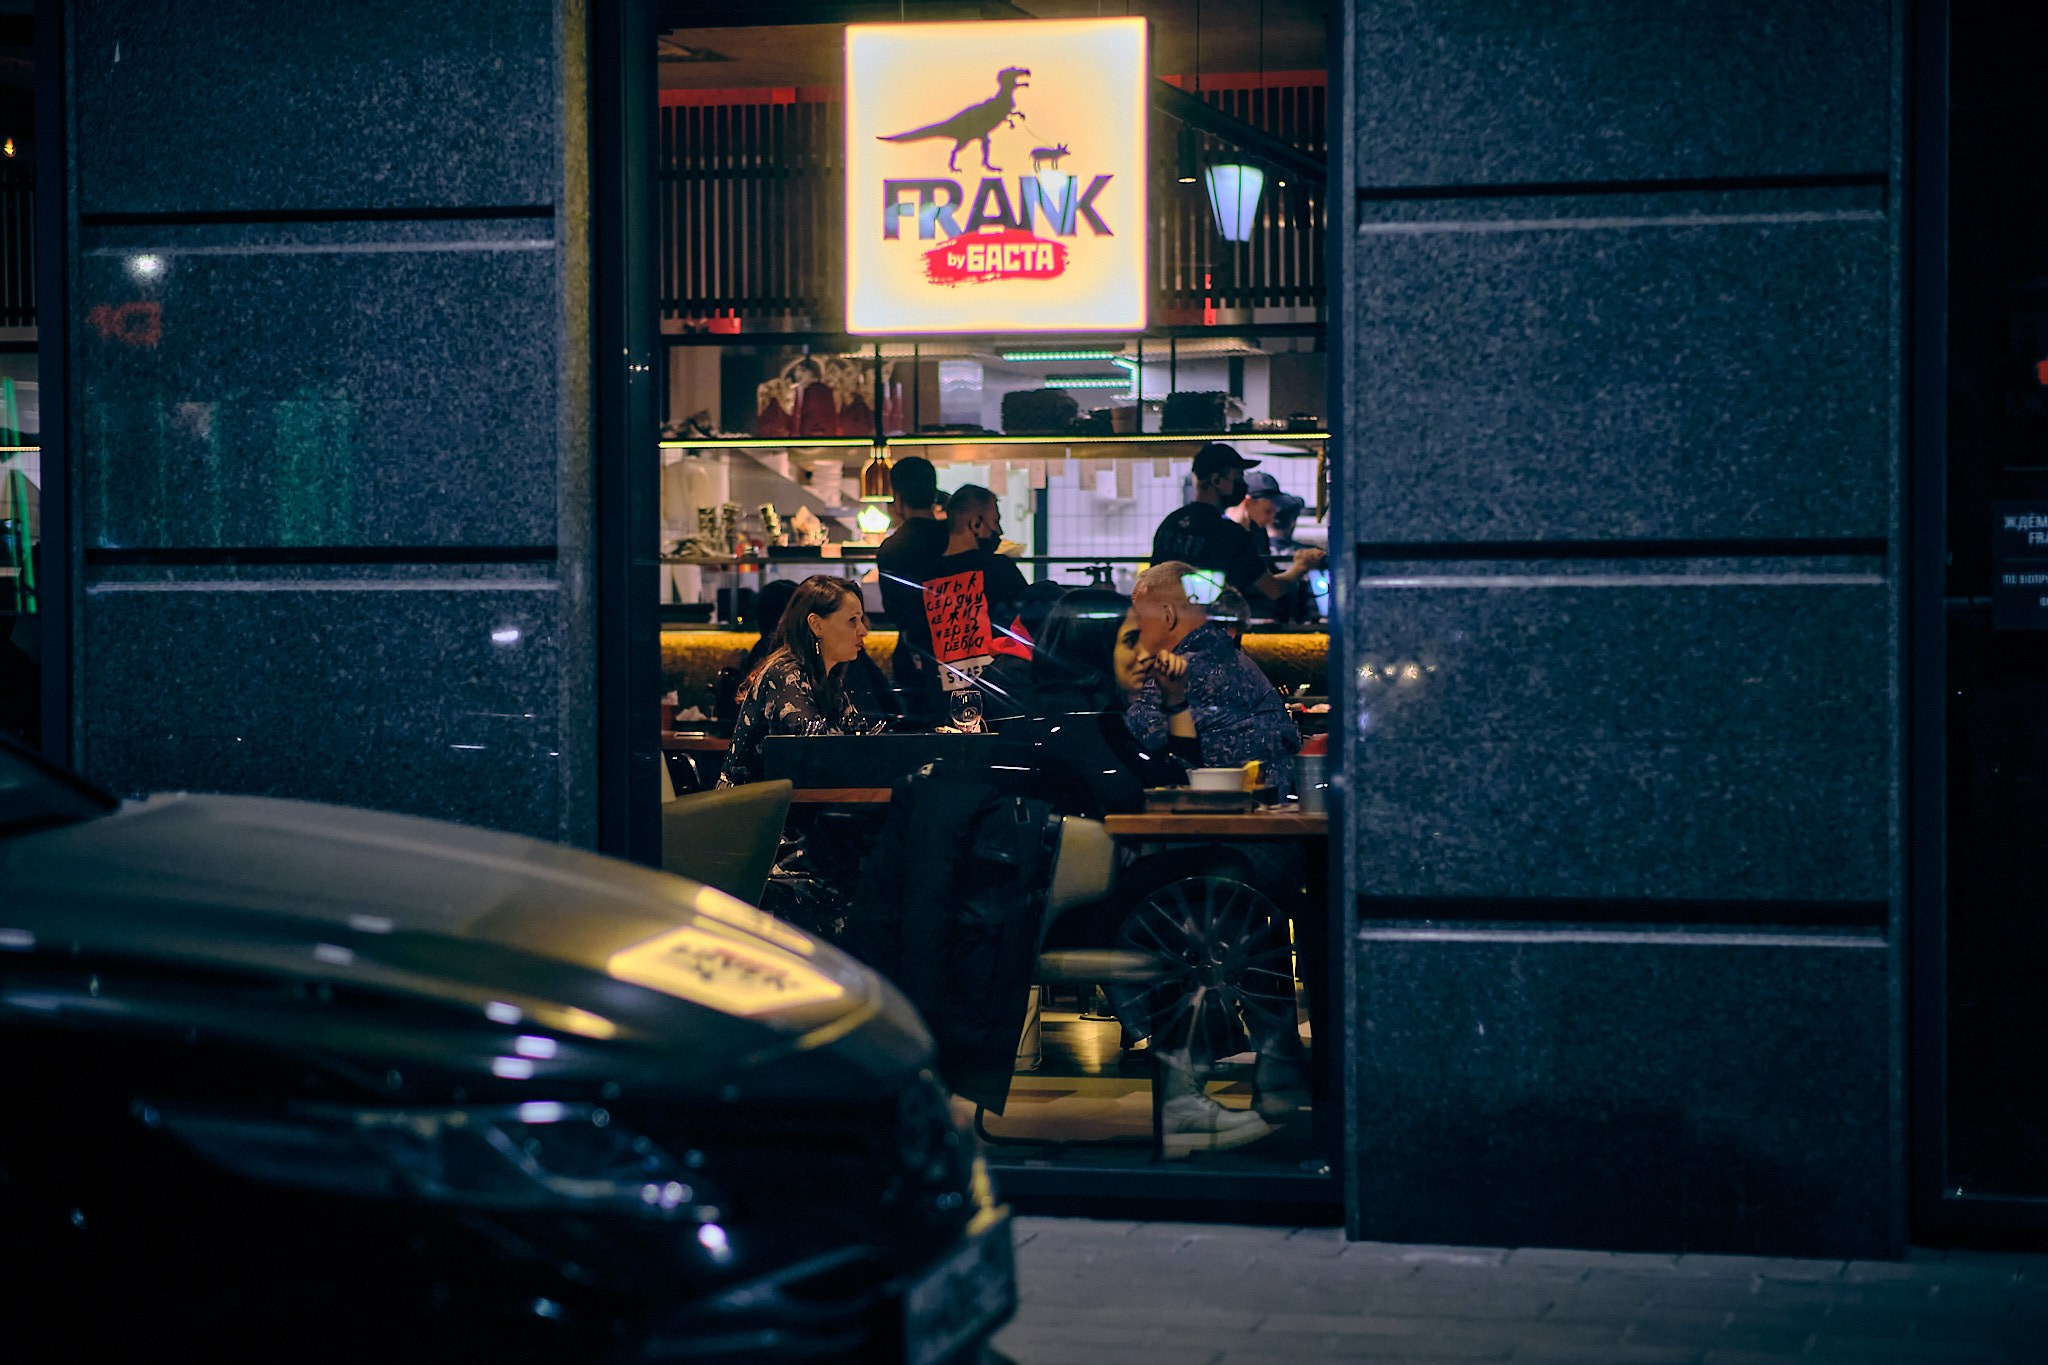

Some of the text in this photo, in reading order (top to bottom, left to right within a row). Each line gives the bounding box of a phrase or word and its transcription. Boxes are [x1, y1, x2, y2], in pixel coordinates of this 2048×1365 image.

[883, 174, 1114, 240] FRANK
[947, 252, 966, 270] by
[946, 665, 989, 684] STAF
